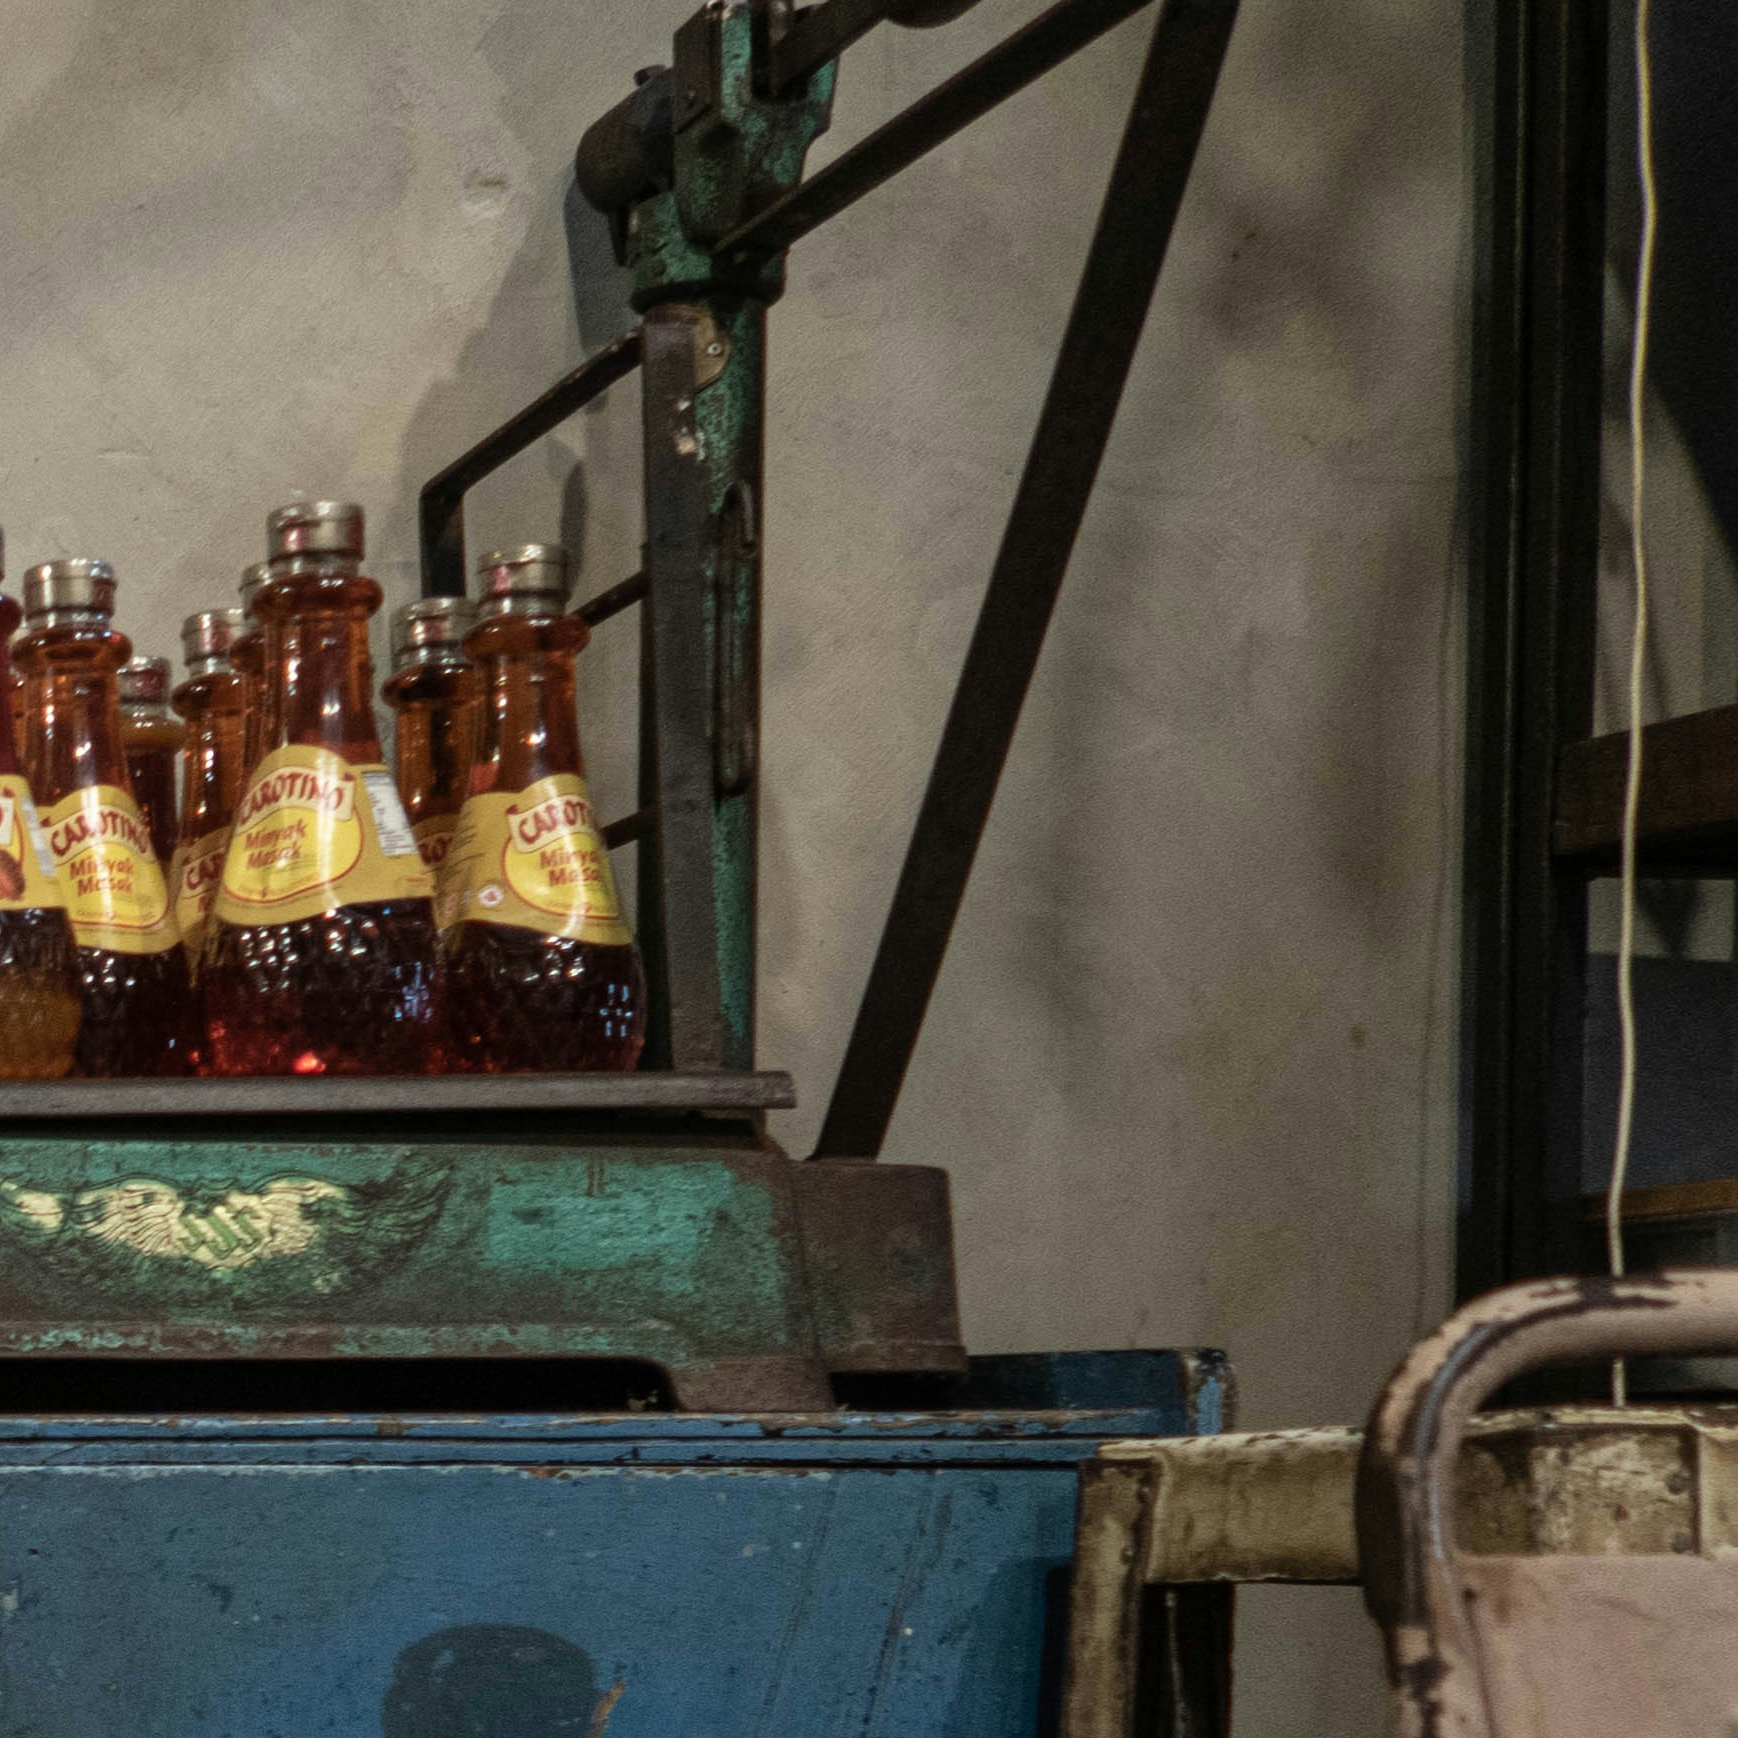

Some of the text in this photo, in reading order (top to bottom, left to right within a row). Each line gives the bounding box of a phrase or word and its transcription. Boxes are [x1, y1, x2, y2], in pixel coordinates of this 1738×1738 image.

[245, 819, 307, 849] Minyak
[519, 800, 589, 845] CAROT
[247, 843, 301, 869] Masak
[539, 848, 599, 870] Minya
[549, 867, 601, 886] Masa
